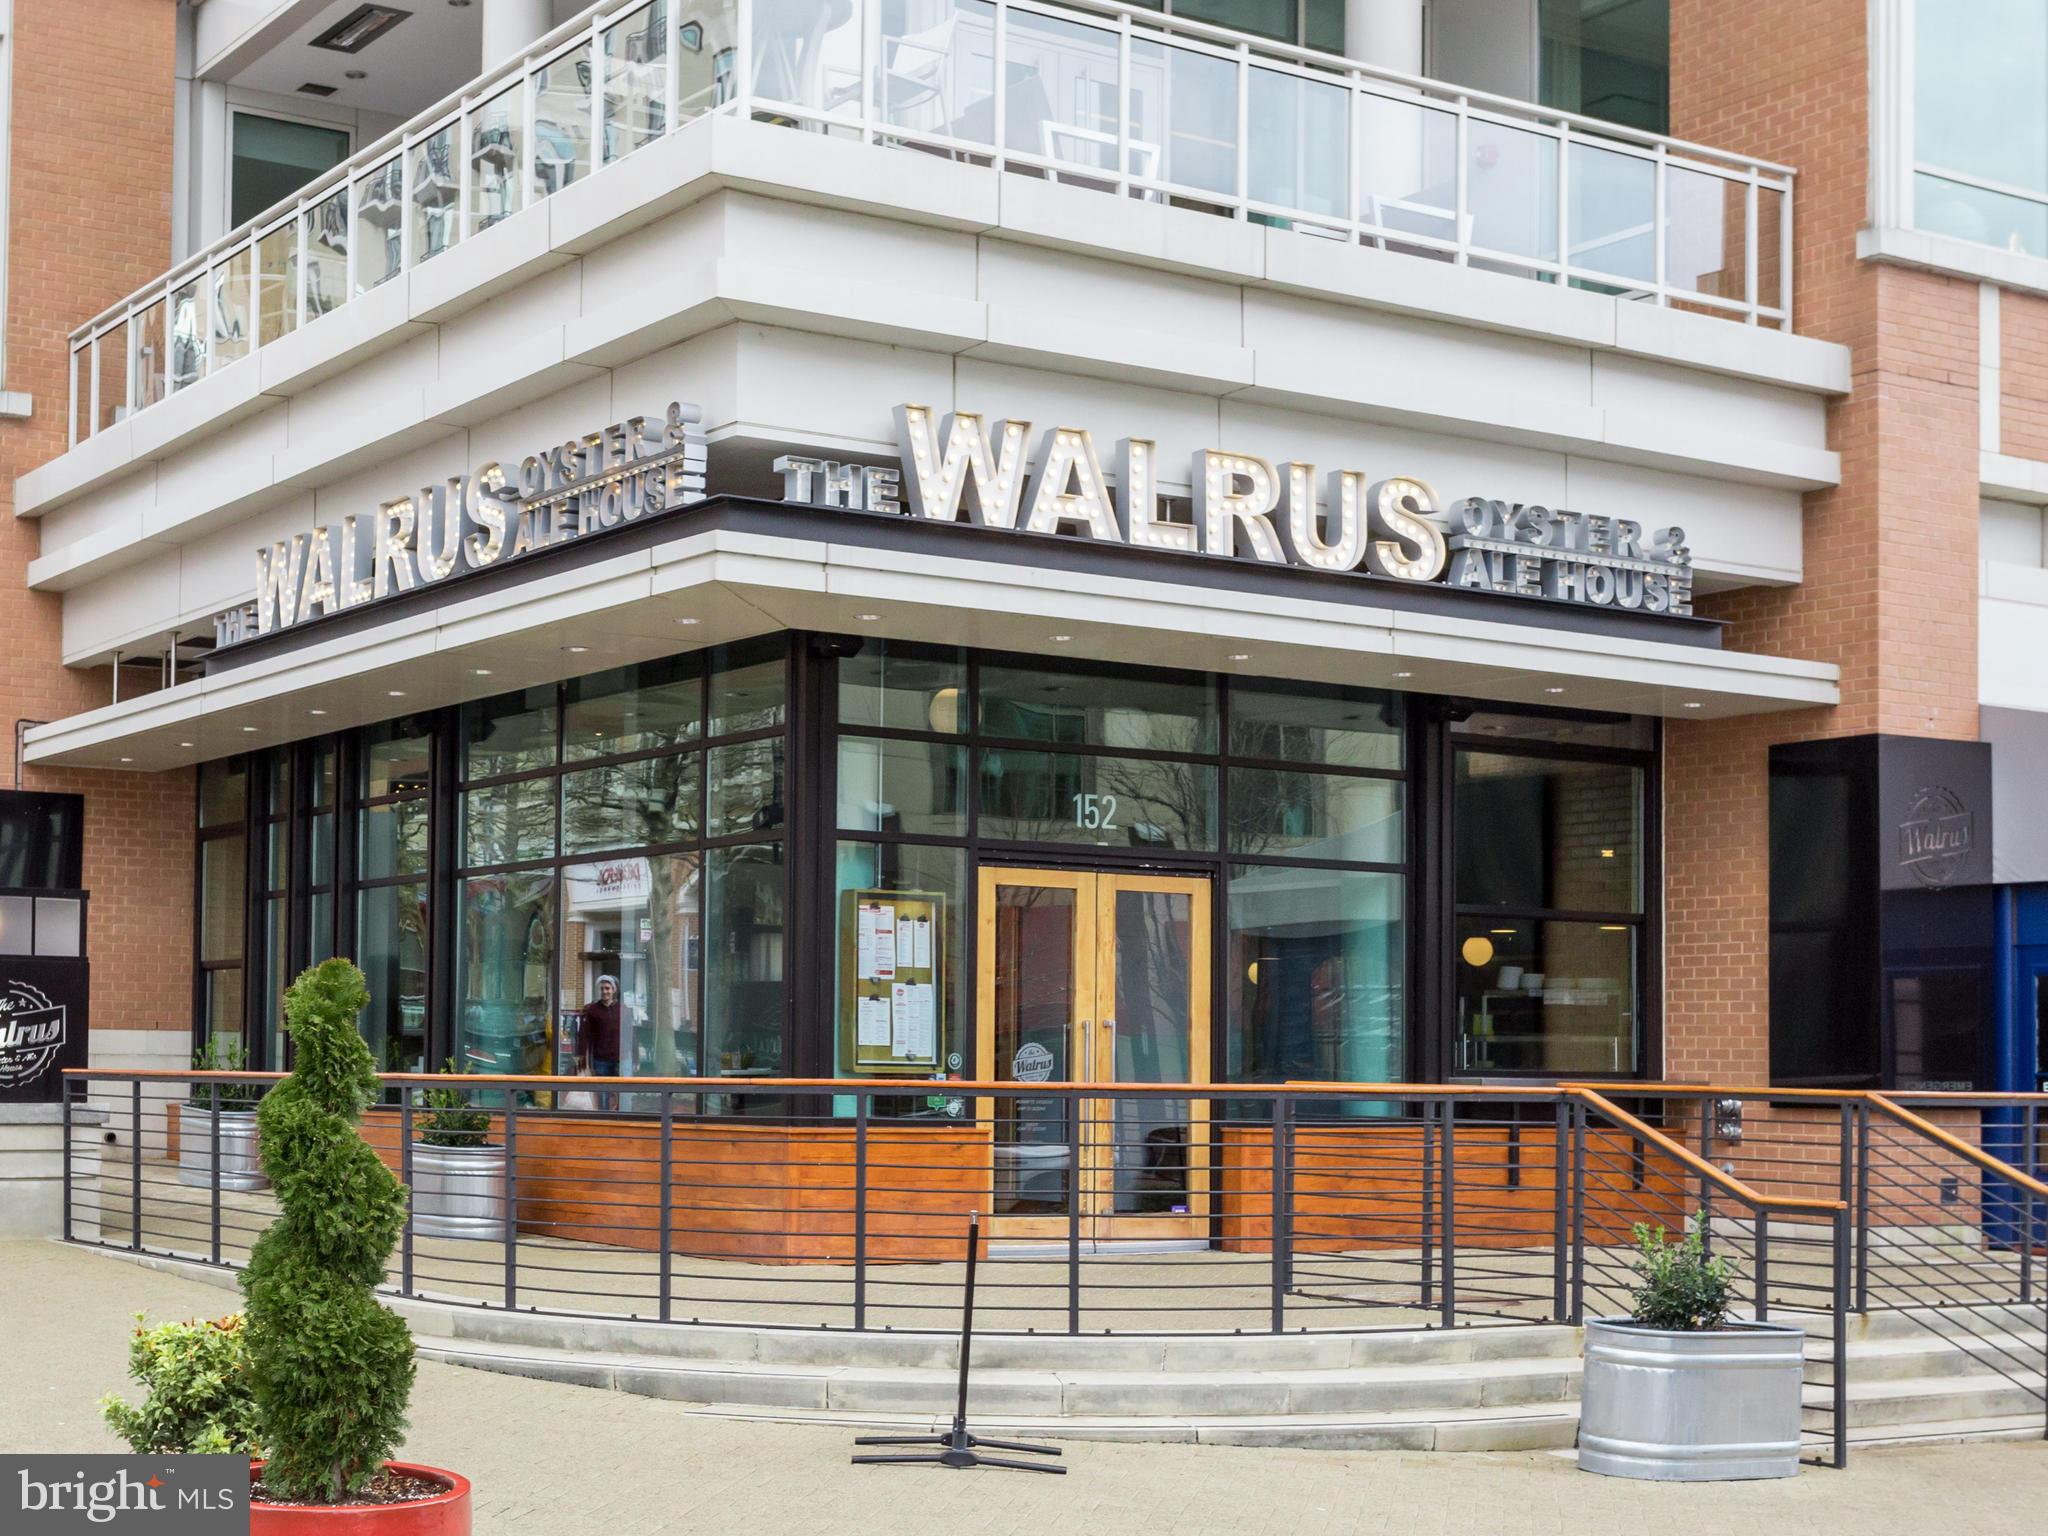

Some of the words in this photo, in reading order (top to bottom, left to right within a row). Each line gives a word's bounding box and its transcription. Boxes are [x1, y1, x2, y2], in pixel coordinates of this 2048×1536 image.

[518, 415, 664, 498] OYSTER
[663, 401, 706, 450] &
[512, 496, 579, 556] ALE
[577, 458, 707, 537] HOUSE
[772, 455, 900, 514] THE
[892, 402, 1447, 583] WALRUS
[213, 604, 259, 649] THE
[255, 461, 518, 634] WALRUS
[1449, 496, 1643, 560] OYSTER
[1653, 526, 1692, 565] &
[1447, 549, 1543, 597] ALE
[1545, 560, 1694, 617] HOUSE
[1072, 793, 1117, 830] 152
[0, 1019, 60, 1048] lrus
[1015, 1058, 1052, 1074] Walrus
